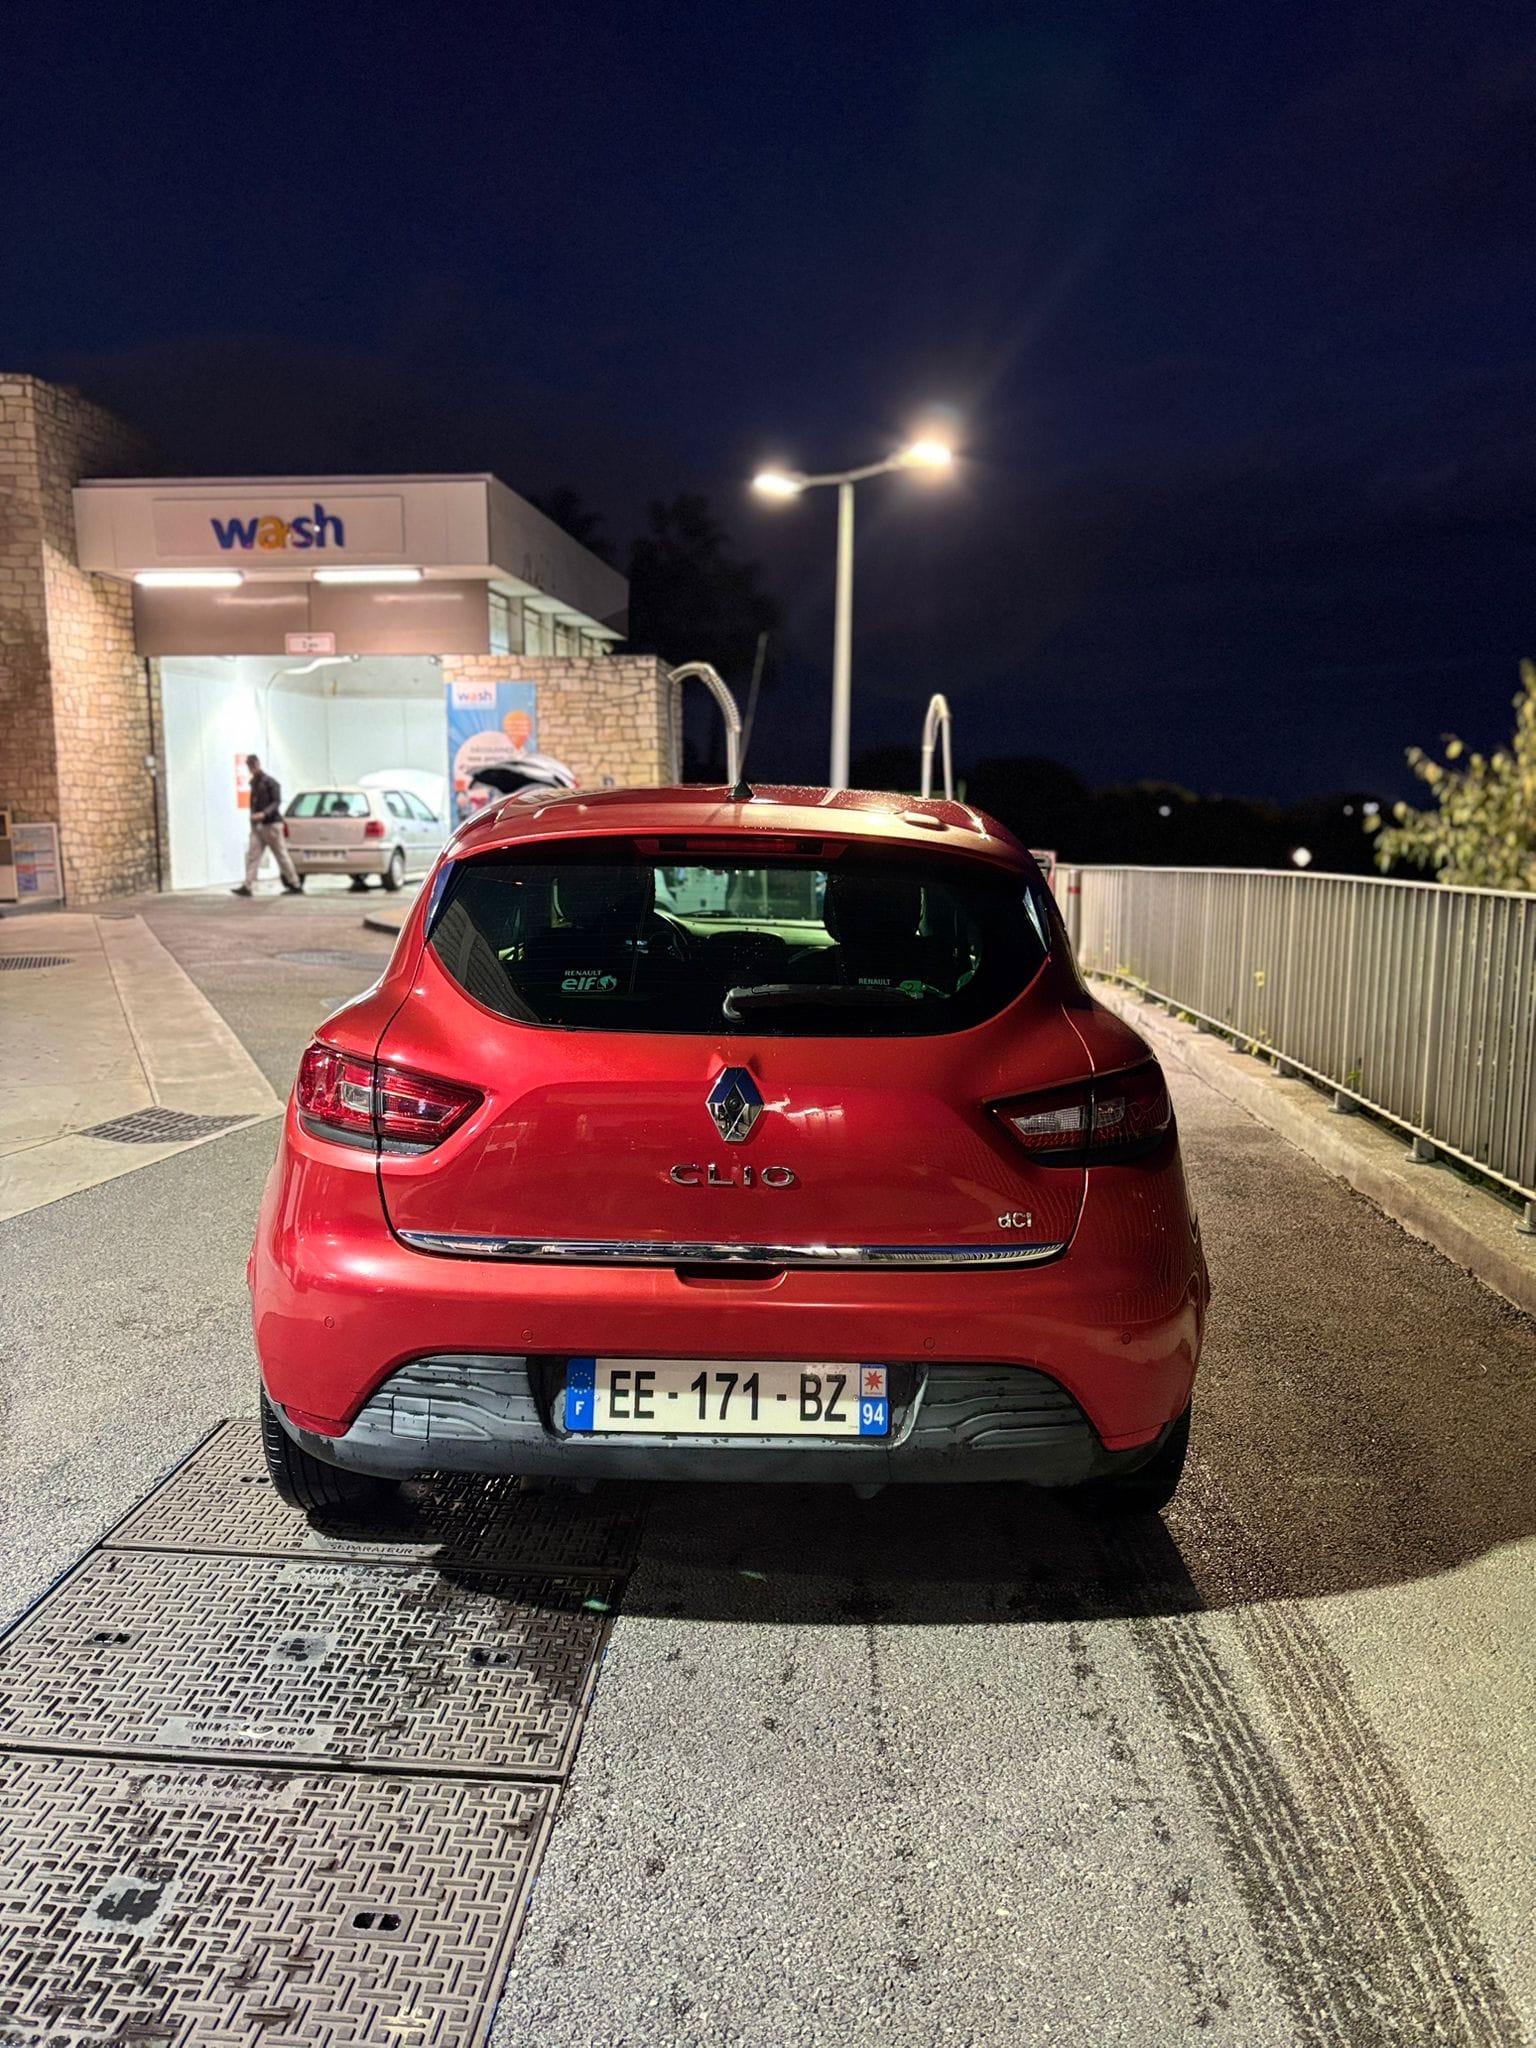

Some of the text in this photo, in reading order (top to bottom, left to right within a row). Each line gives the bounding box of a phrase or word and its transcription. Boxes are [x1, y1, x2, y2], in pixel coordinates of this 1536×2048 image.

[210, 502, 344, 550] wash
[457, 690, 493, 702] wash
[564, 969, 602, 977] RENAULT
[561, 976, 598, 990] elf
[858, 977, 890, 986] RENAULT
[669, 1163, 796, 1187] CLIO
[575, 1401, 585, 1416] F
[862, 1402, 885, 1426] 94
[191, 1735, 296, 1749] SEPARATEUR
